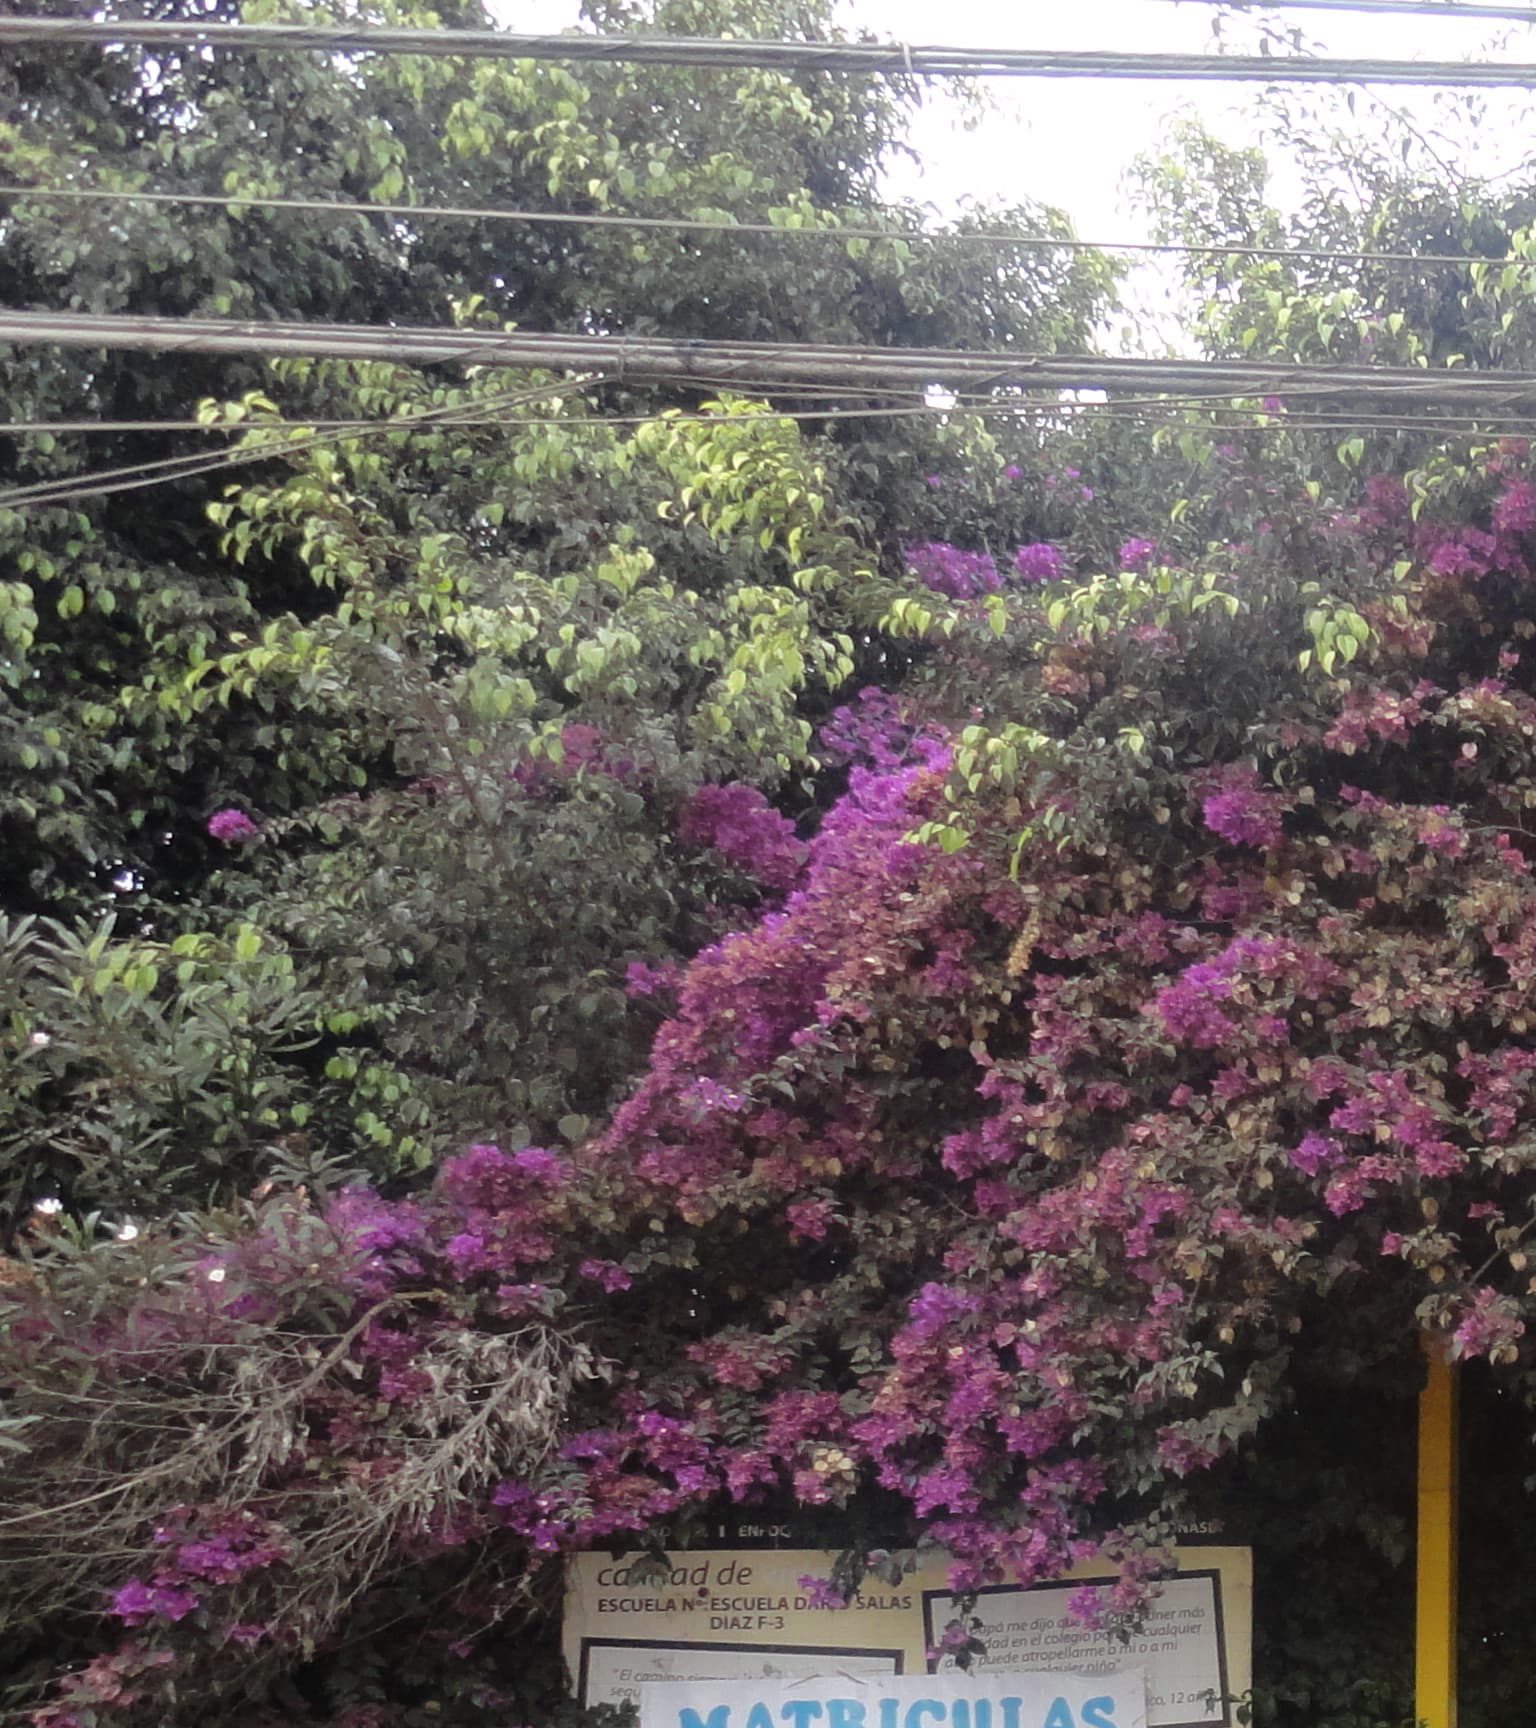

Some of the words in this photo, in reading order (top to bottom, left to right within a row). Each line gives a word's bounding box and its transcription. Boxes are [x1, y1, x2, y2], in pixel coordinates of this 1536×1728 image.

[716, 1560, 752, 1586] de
[598, 1599, 676, 1612] ESCUELA
[710, 1597, 789, 1612] ESCUELA
[855, 1595, 912, 1610] SALAS
[710, 1616, 753, 1630] DIAZ
[757, 1615, 784, 1630] F-3
[1006, 1620, 1028, 1632] me
[1030, 1618, 1055, 1634] dijo
[1011, 1637, 1028, 1648] en
[1030, 1634, 1042, 1647] el
[1044, 1630, 1091, 1646] colegio
[978, 1651, 1020, 1667] puede
[1021, 1645, 1106, 1663] atropellarme
[1170, 1691, 1185, 1704] 12
